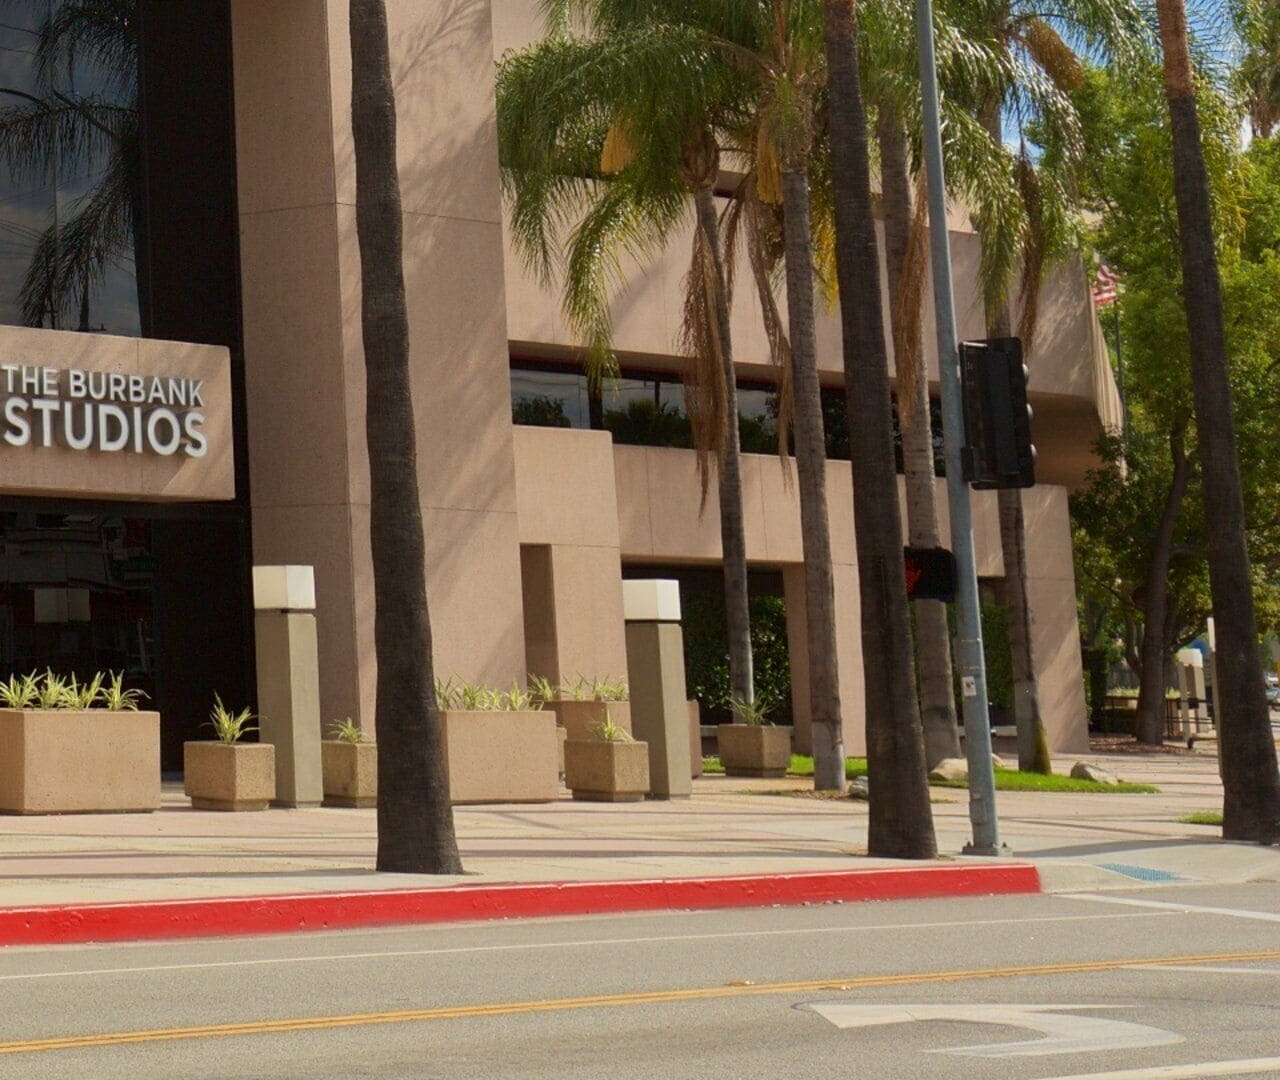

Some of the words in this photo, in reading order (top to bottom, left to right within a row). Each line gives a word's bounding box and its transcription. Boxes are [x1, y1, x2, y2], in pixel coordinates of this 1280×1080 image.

[0, 364, 59, 396] THE
[69, 368, 205, 407] BURBANK
[3, 399, 208, 458] STUDIOS
